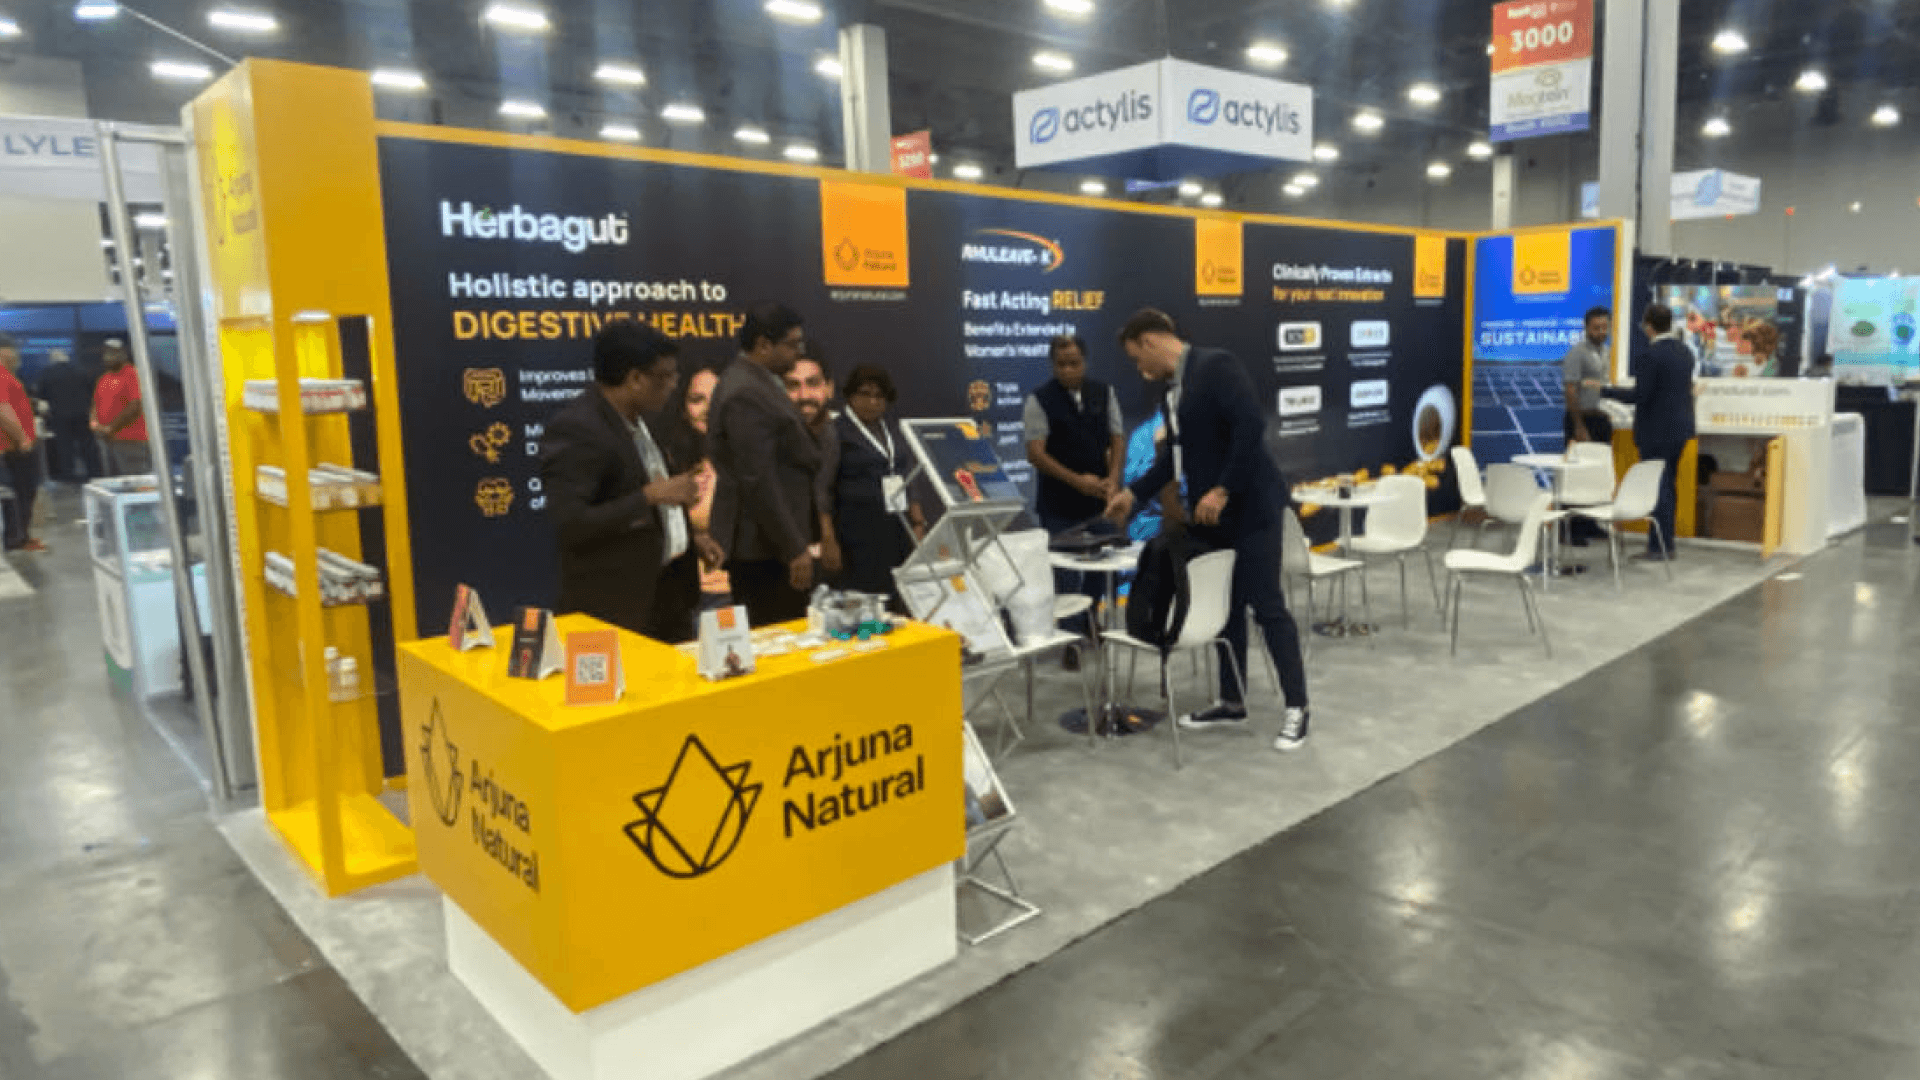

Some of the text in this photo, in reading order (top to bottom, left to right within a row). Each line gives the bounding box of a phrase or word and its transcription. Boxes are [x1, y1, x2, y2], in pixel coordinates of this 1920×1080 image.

[1510, 21, 1574, 53] 3000
[1063, 88, 1151, 132] actylis
[1223, 97, 1300, 135] actylis
[4, 133, 96, 158] LYLE
[440, 199, 629, 253] Herbagut
[449, 272, 728, 305] Holistic approach to
[962, 289, 997, 311] Fast
[1000, 290, 1050, 316] Acting
[453, 311, 630, 339] DIGESTIV
[783, 724, 913, 788] Arjuna
[469, 758, 531, 836] Arjuna
[783, 754, 925, 839] Natural
[471, 805, 541, 894] Natural
